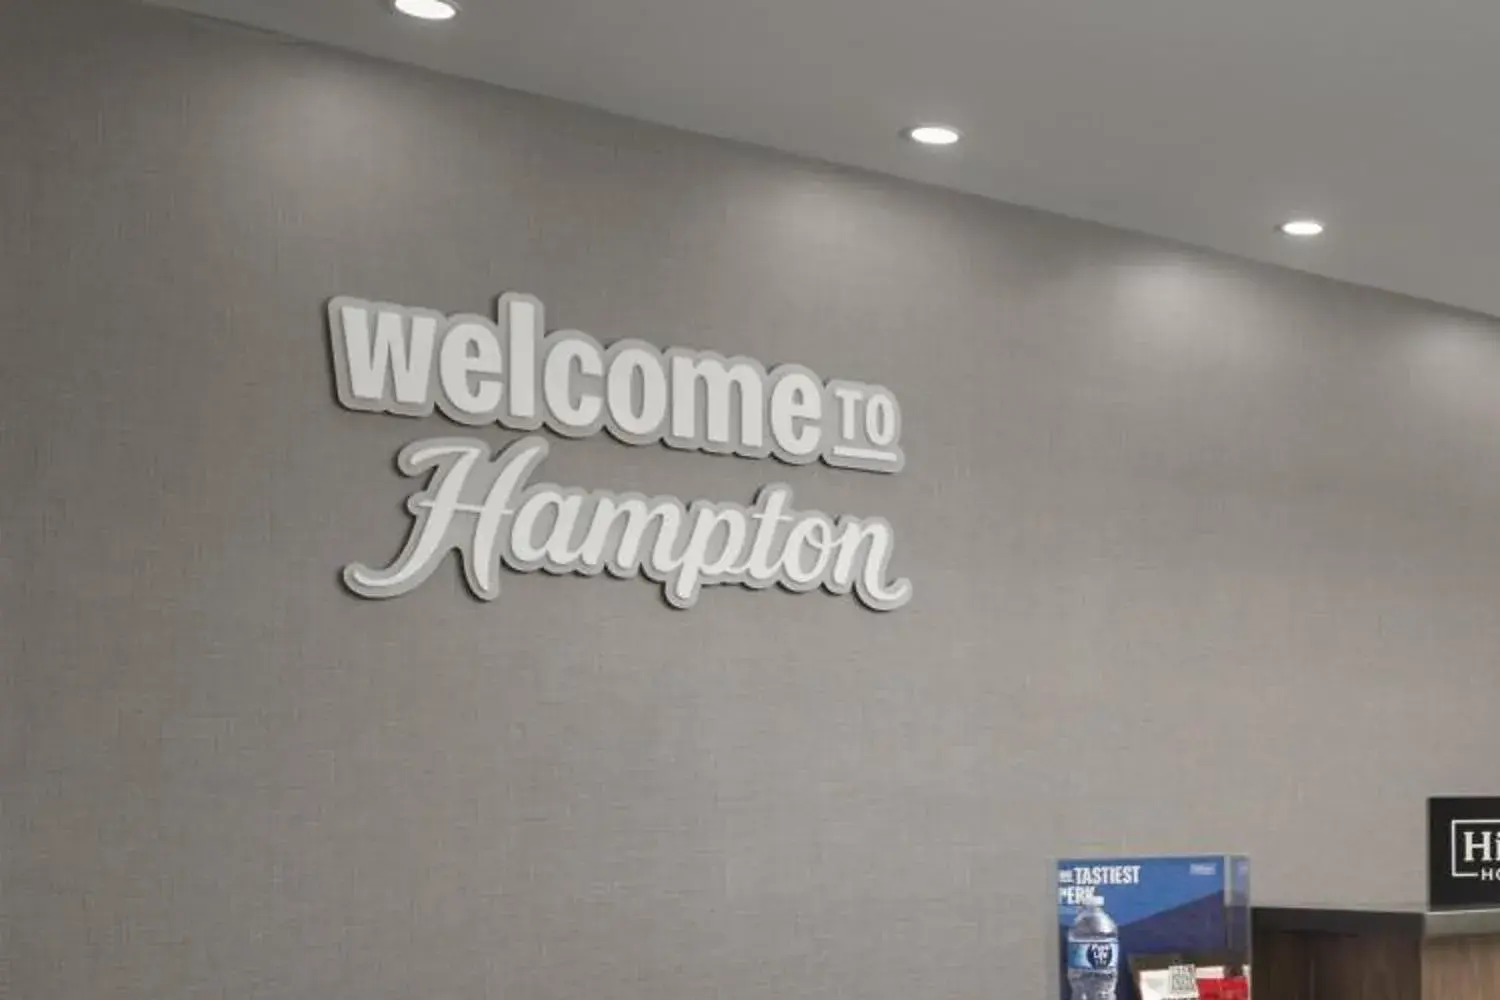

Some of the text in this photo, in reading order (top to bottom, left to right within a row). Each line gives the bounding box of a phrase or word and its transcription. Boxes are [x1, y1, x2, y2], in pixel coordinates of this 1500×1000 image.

[337, 297, 899, 455] welcome TO
[350, 443, 911, 601] Hampton
[1074, 865, 1141, 885] TASTIEST
